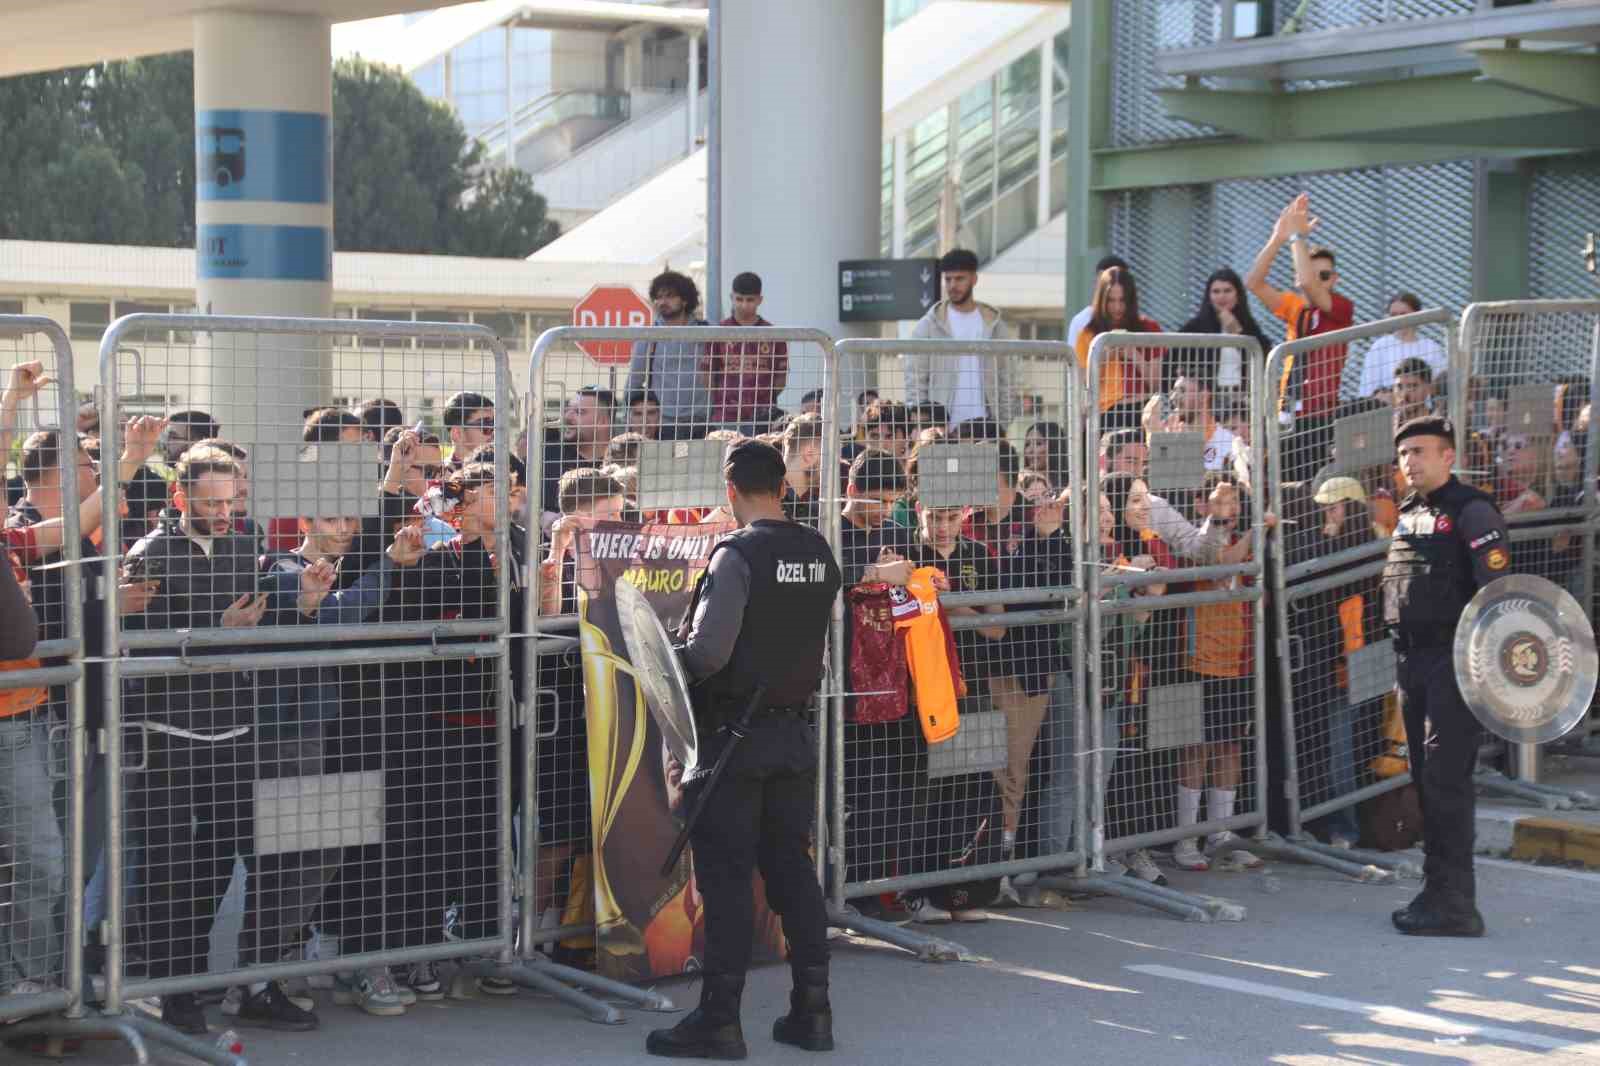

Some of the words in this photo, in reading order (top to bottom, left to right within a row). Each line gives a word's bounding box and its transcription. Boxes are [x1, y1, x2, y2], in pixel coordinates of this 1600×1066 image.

[589, 532, 643, 560] THERE
[643, 534, 666, 560] IS
[667, 534, 710, 560] ONLY
[623, 567, 684, 595] MAURO
[776, 559, 806, 583] ÖZEL
